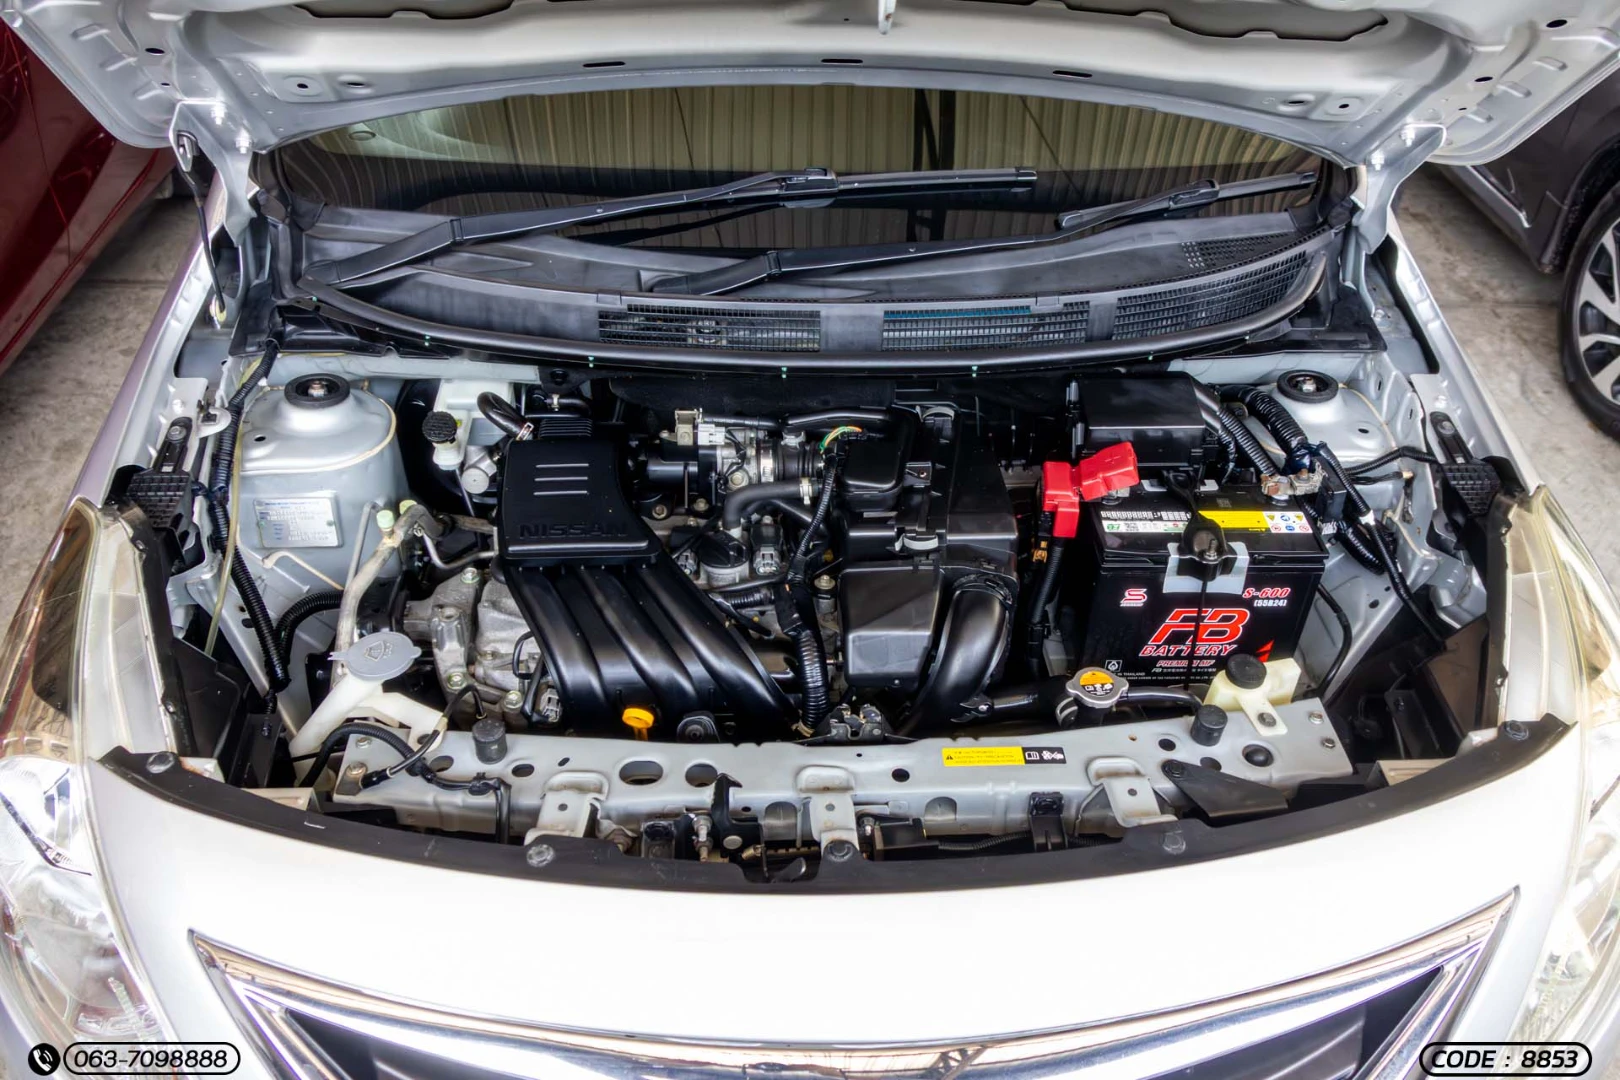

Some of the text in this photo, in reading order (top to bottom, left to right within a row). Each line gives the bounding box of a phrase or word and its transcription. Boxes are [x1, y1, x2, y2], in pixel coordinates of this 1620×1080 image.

[519, 522, 628, 539] NISSAN
[1242, 587, 1291, 598] S-600
[1147, 608, 1250, 644] FB
[1138, 645, 1238, 656] BATTERY
